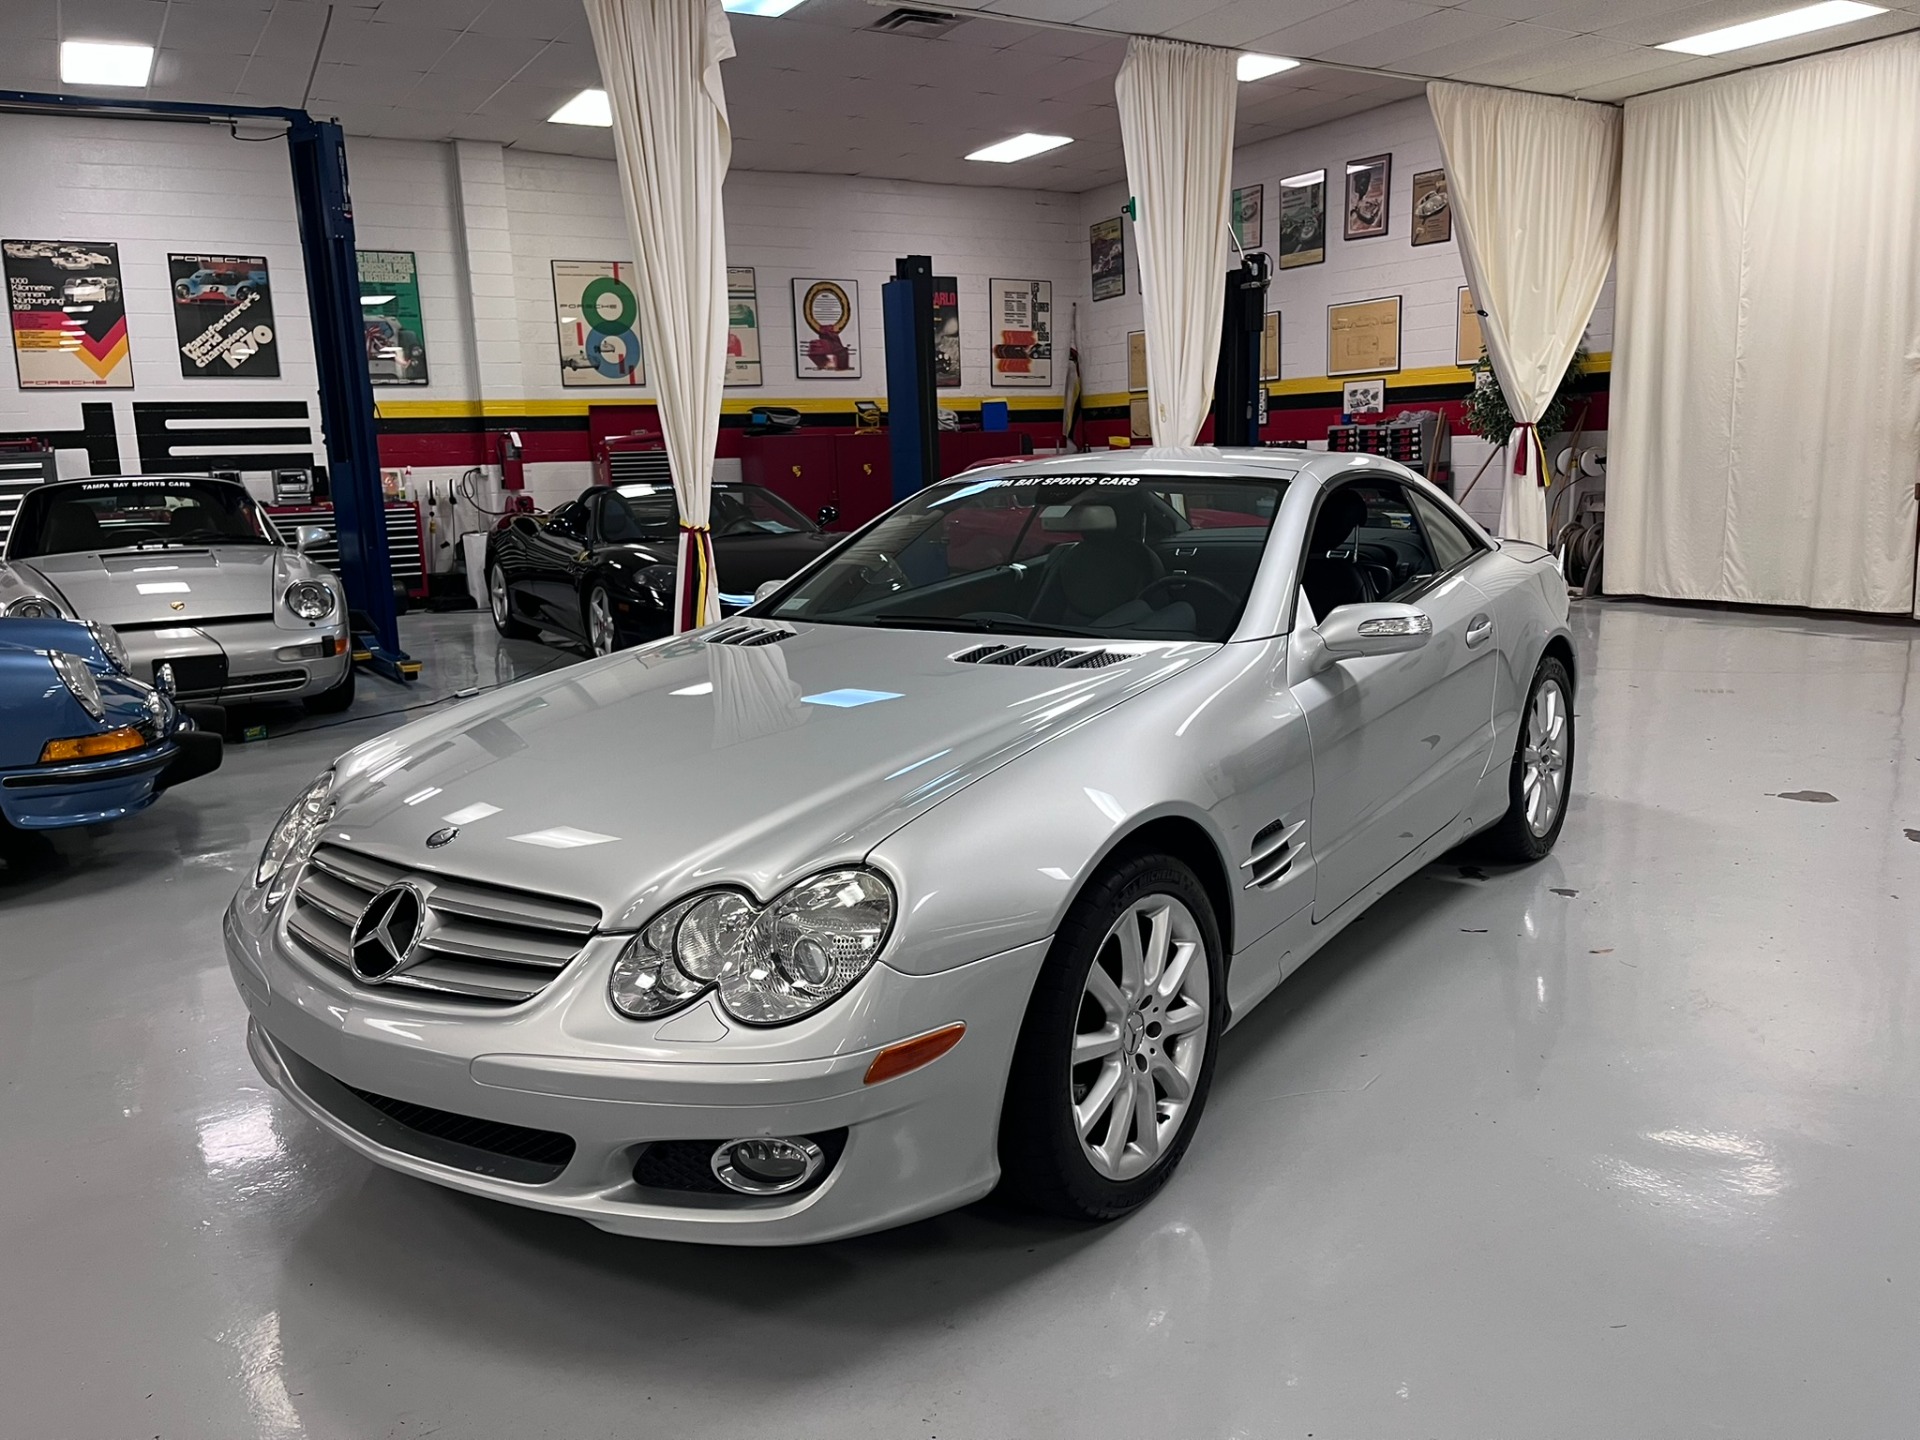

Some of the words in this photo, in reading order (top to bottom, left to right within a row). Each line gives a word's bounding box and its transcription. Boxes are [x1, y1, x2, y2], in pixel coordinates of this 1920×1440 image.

[171, 255, 263, 264] PORSCHE
[10, 277, 29, 285] 1000
[933, 291, 956, 306] ARLO
[181, 292, 260, 354] Manufacturer's
[188, 332, 223, 360] World
[195, 327, 247, 368] Champion
[222, 325, 273, 369] 1970
[1014, 478, 1042, 487] BAY
[1041, 477, 1097, 487] SPORTS
[1098, 477, 1141, 487] CARS
